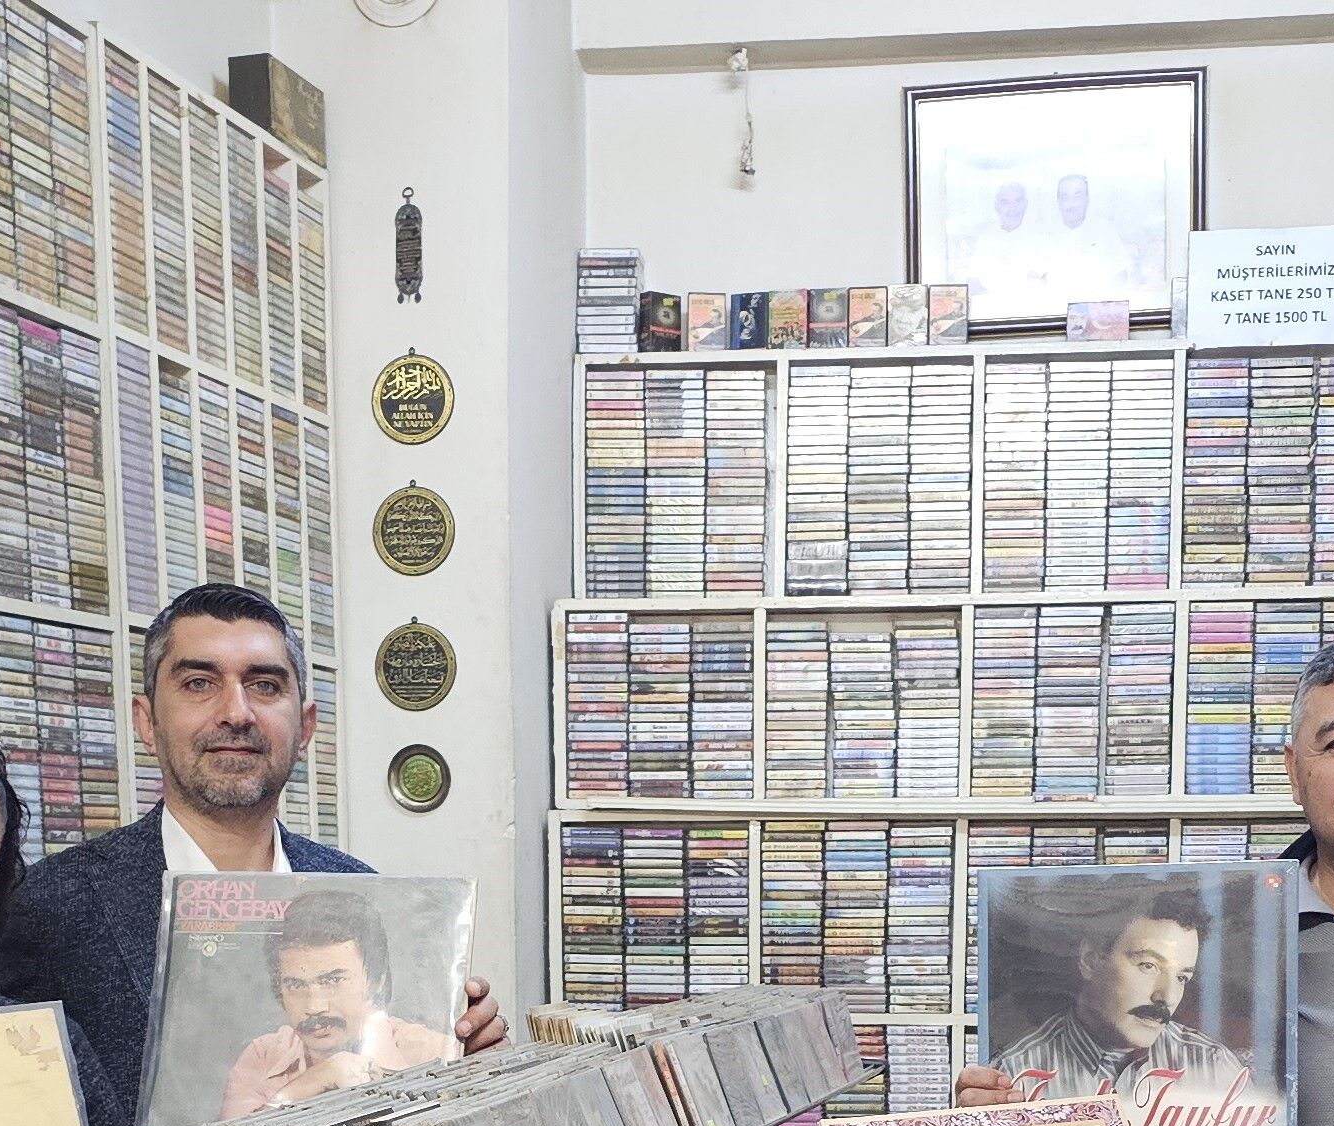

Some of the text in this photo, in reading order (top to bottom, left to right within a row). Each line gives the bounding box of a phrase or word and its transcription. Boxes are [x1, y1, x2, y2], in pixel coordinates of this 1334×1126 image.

[1255, 244, 1296, 256] SAYIN
[1217, 263, 1334, 281] MÜŞTERİLERİMİZ
[1211, 290, 1253, 302] KASET
[1257, 289, 1292, 300] TANE
[1297, 288, 1321, 299] 250
[1223, 310, 1327, 324] 7 TANE 1500 TL
[178, 880, 256, 899] ORHAN
[176, 899, 292, 920] GENCEBAY
